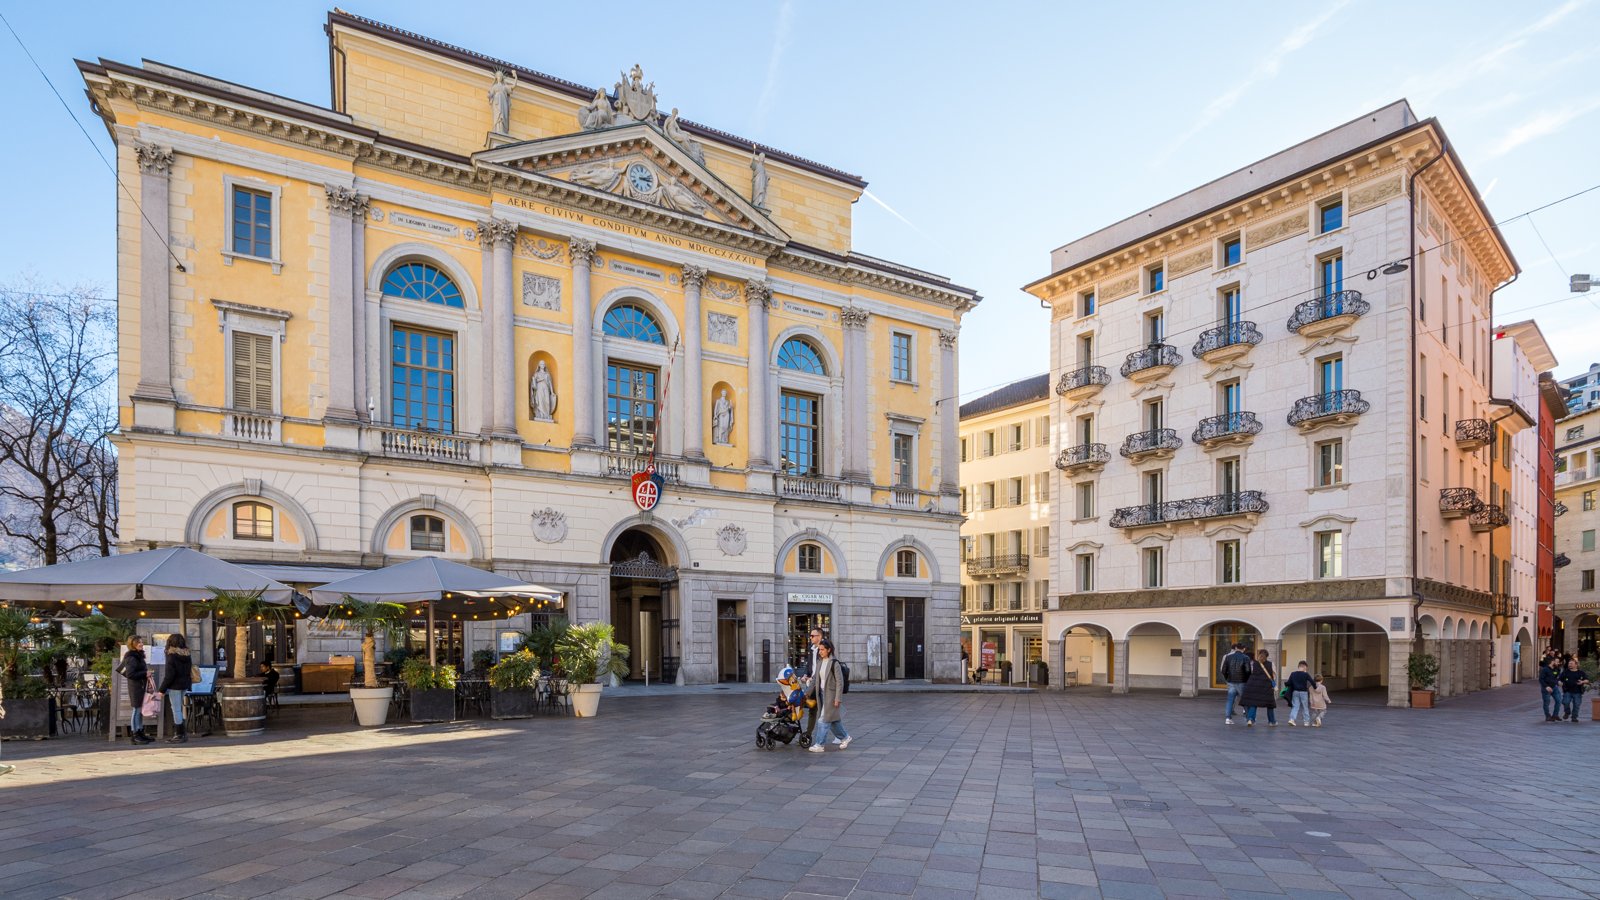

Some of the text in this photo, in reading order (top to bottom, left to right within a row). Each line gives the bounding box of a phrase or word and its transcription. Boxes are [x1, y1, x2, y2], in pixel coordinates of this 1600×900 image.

[507, 197, 758, 265] AERE CIVIVM CONDITVM ANNO MDCCCXXXXIV
